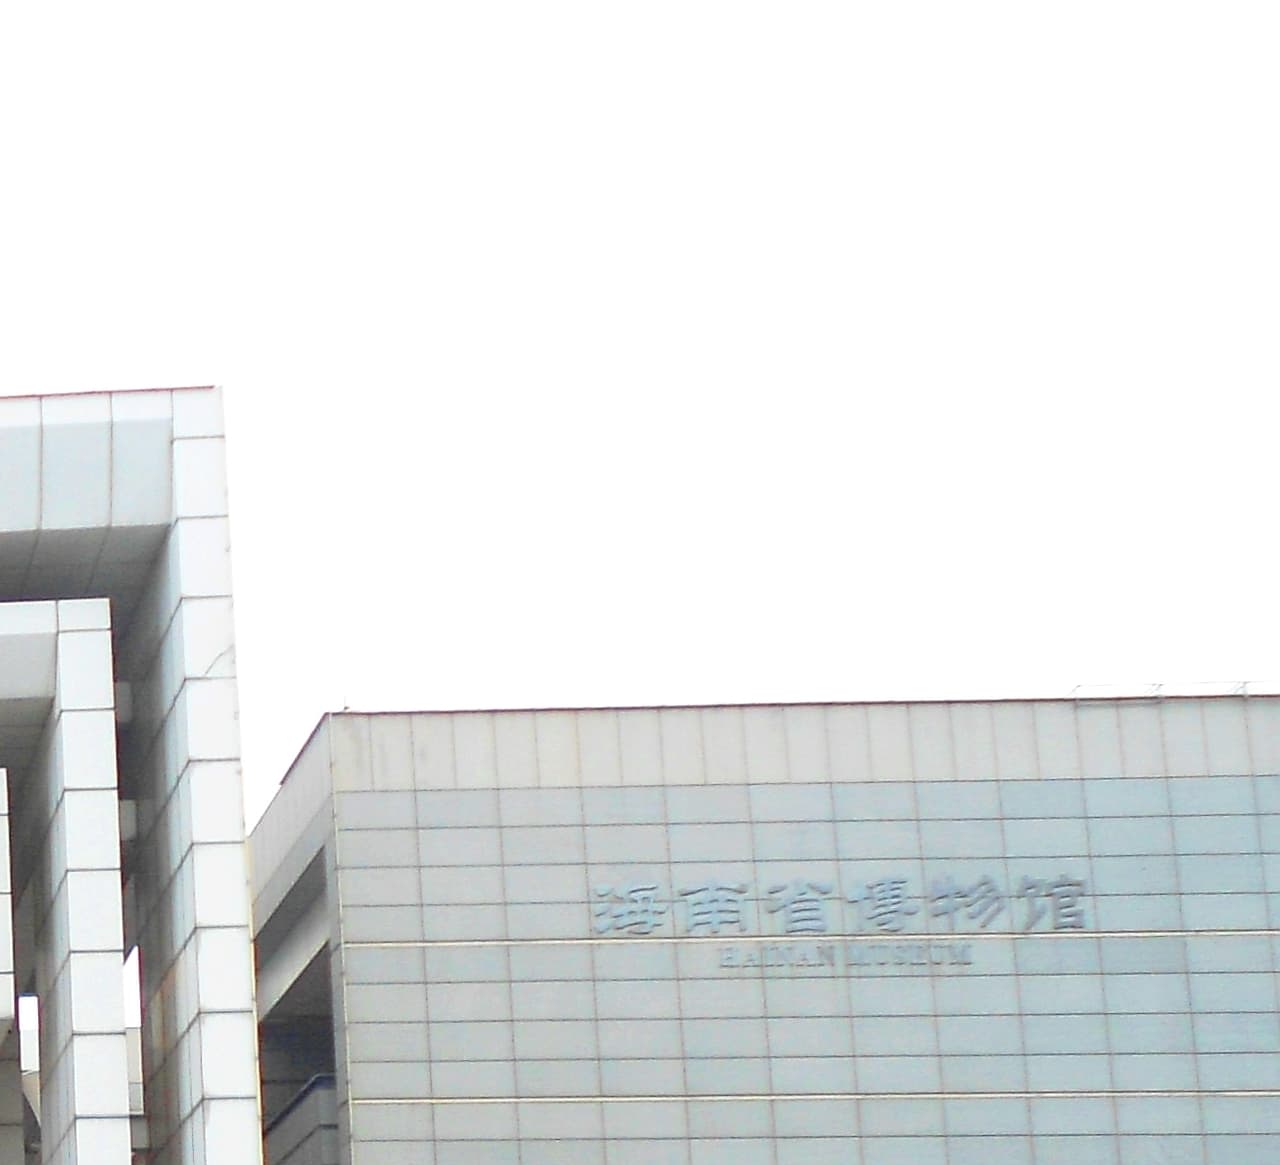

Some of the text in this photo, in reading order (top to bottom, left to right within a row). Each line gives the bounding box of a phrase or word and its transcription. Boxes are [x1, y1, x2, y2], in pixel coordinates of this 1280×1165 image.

[592, 873, 1088, 936] 海南省博物馆
